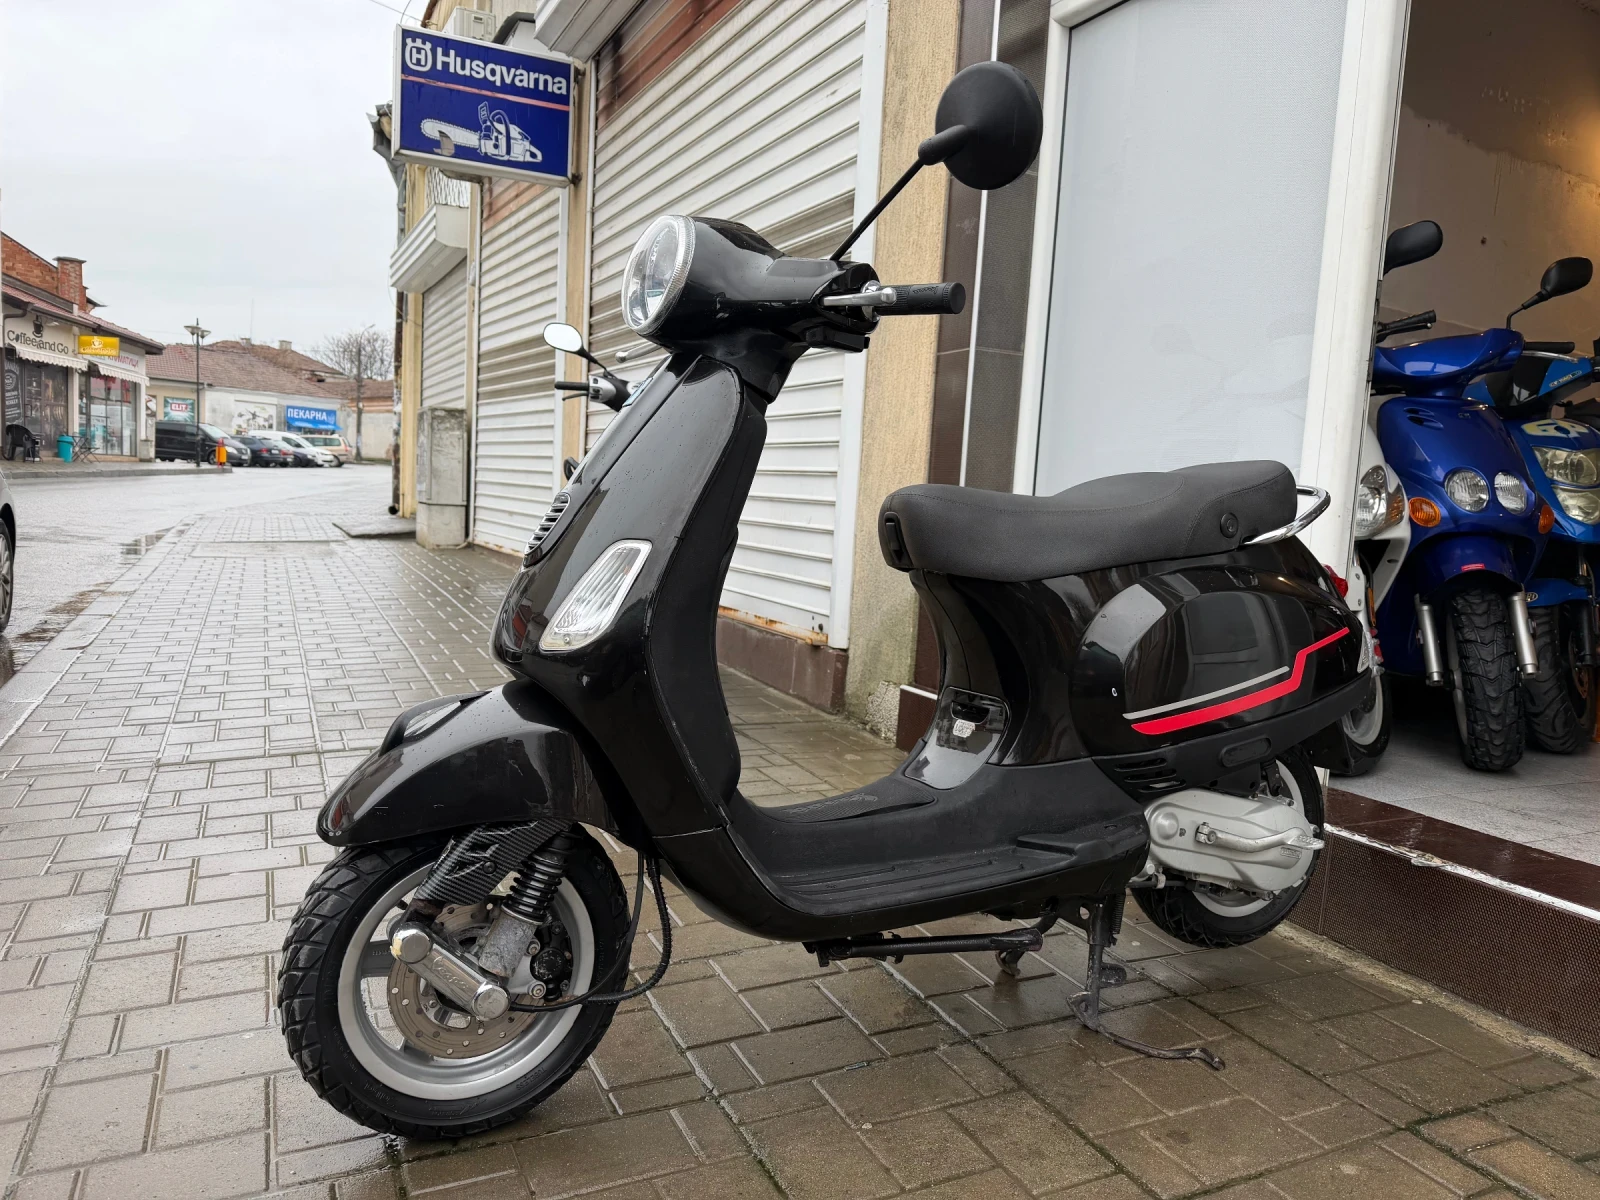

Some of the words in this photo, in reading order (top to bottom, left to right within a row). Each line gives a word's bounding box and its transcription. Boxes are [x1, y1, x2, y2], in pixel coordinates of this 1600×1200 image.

[436, 47, 567, 95] Husqvarna
[7, 329, 39, 347] Coffee
[39, 340, 56, 353] and
[56, 342, 69, 355] Go
[171, 403, 187, 411] ELIT
[287, 408, 327, 421] ПЕКАРНА
[516, 1066, 547, 1091] TUBELESS
